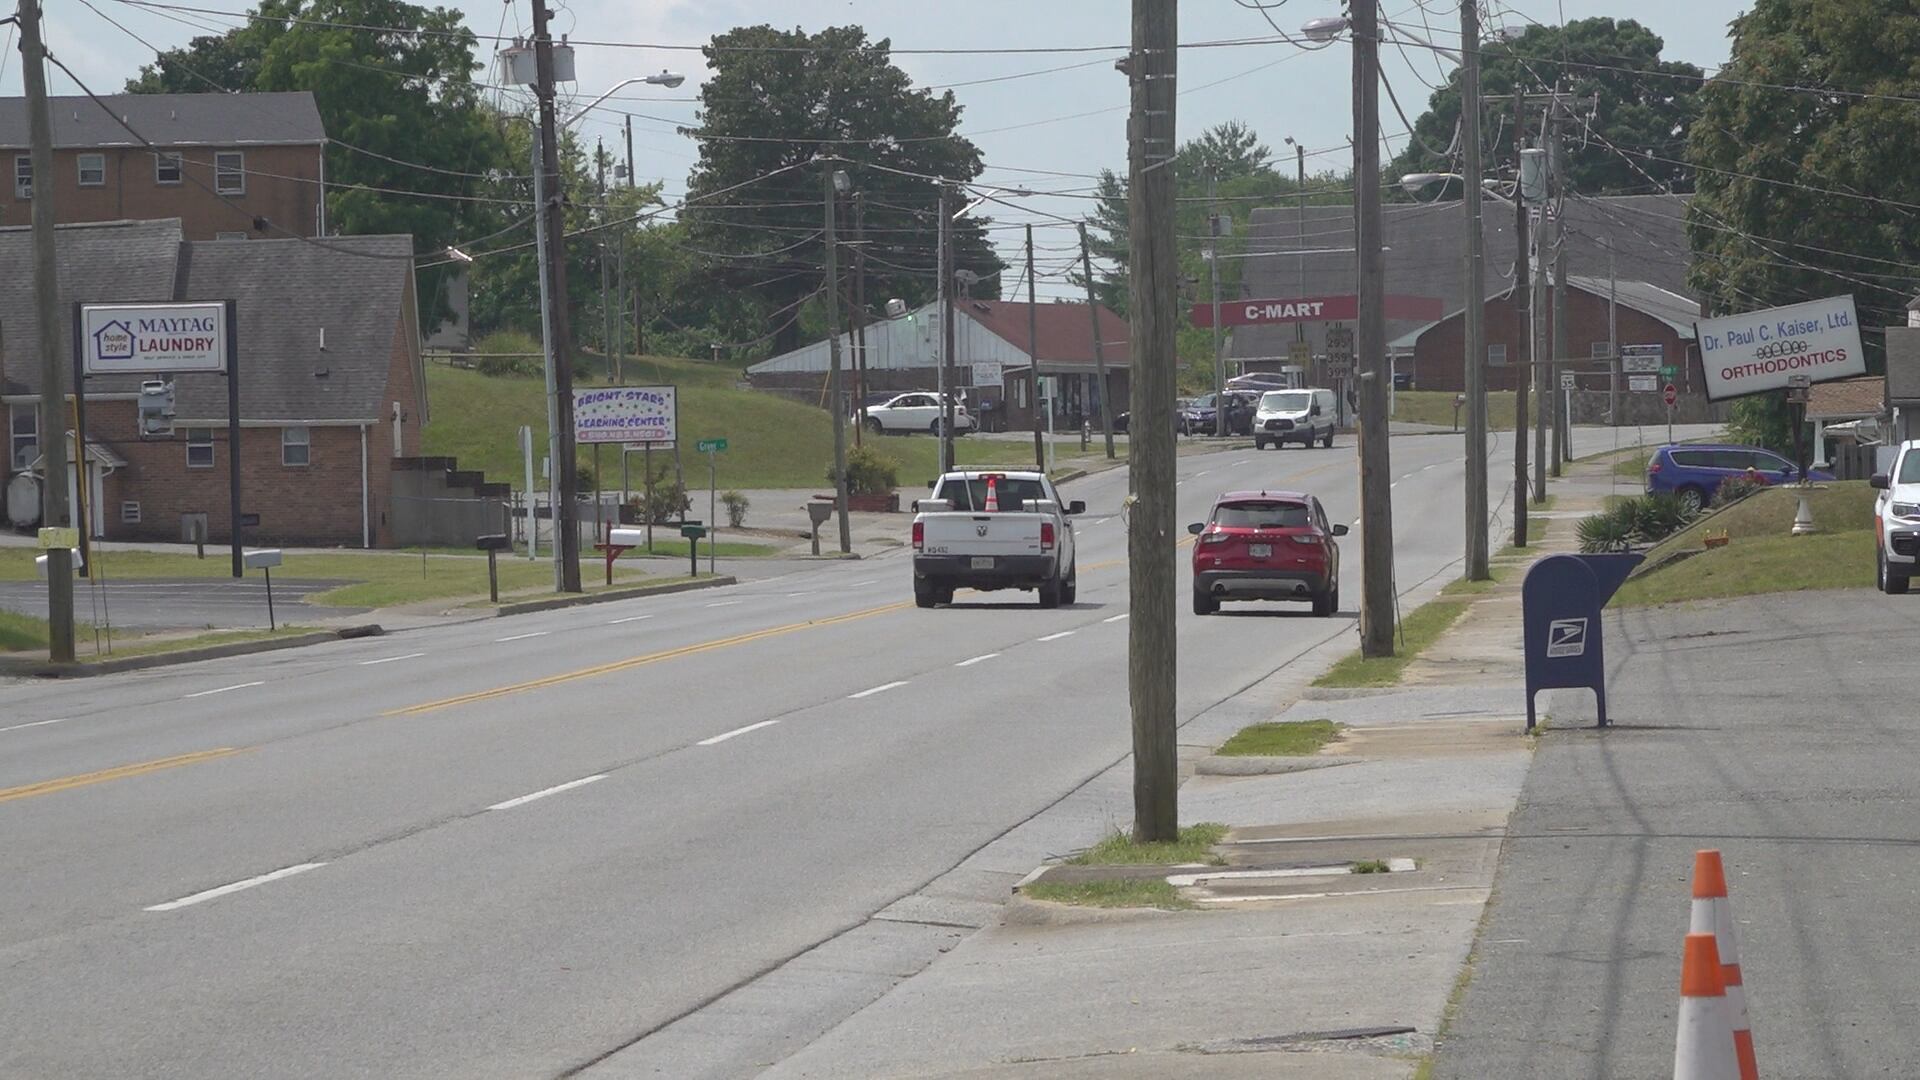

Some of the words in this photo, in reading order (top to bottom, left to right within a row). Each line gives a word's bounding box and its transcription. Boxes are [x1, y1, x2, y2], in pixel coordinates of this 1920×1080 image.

[1245, 302, 1324, 319] C-MART
[138, 317, 215, 333] MAYTAG
[1704, 335, 1723, 350] Dr.
[1727, 327, 1755, 346] Paul
[1759, 325, 1773, 341] C.
[1777, 319, 1824, 338] Kaiser,
[1827, 311, 1852, 329] Ltd.
[103, 333, 128, 342] home
[139, 338, 215, 352] LAUNDRY
[105, 343, 128, 353] style
[1721, 349, 1847, 380] ORTHODONTICS
[577, 391, 622, 407] BRIGHT
[625, 391, 665, 406] STARS
[578, 418, 625, 428] LEARNING
[627, 416, 665, 427] CENTER
